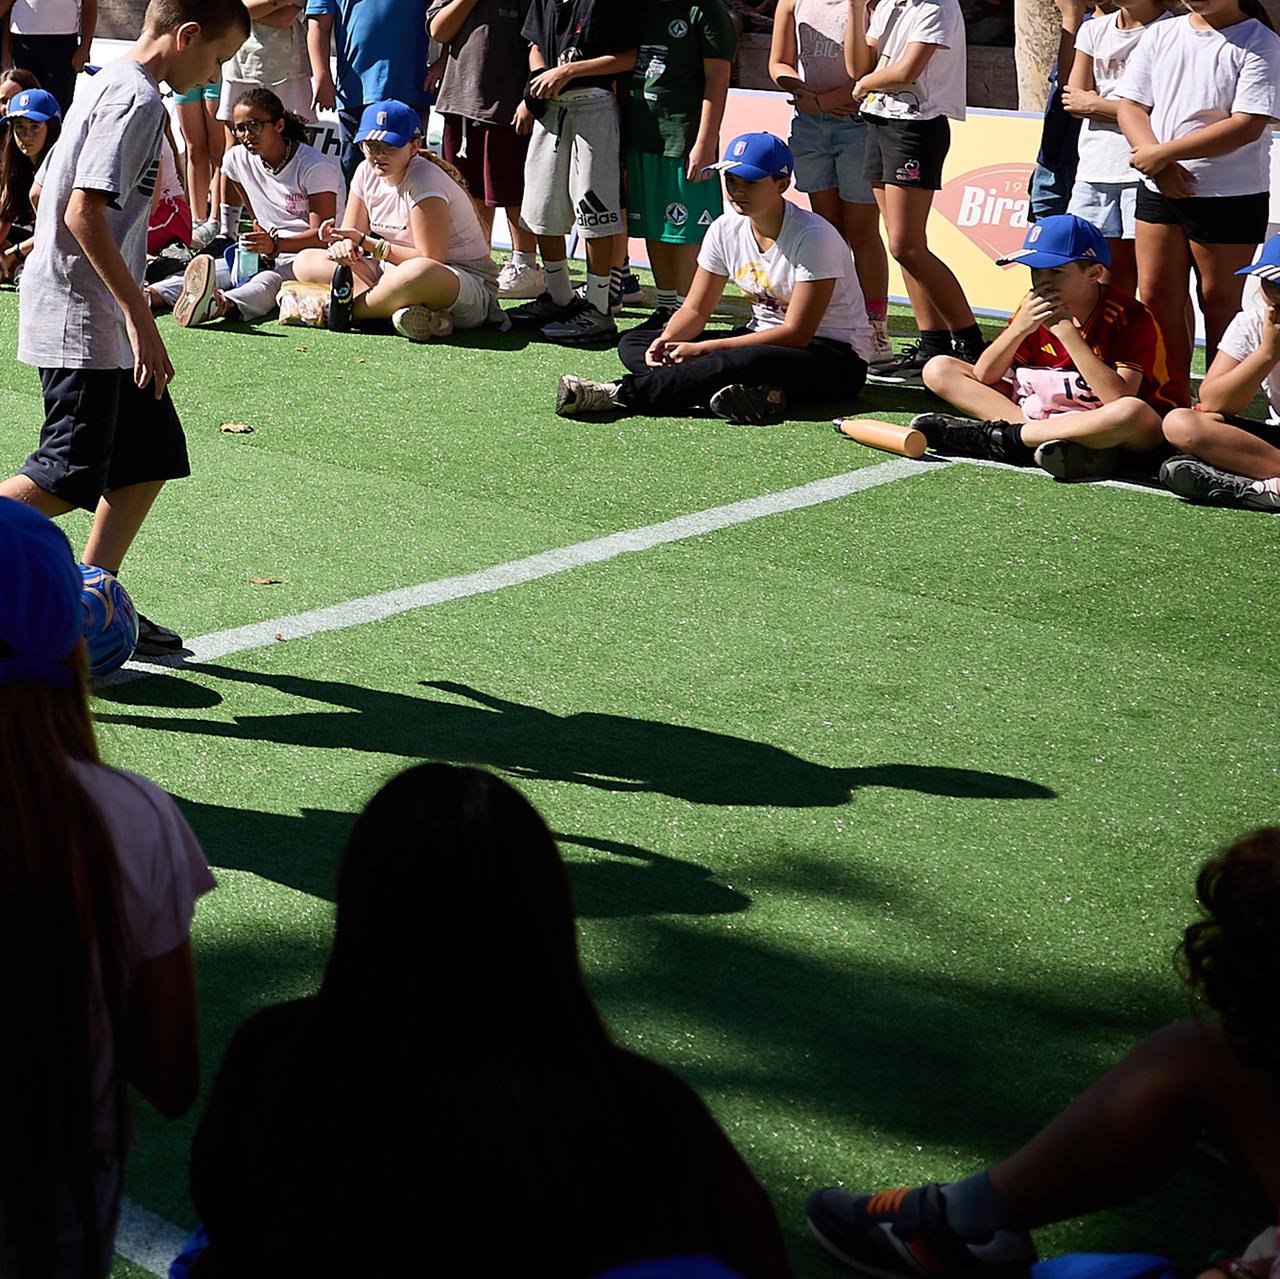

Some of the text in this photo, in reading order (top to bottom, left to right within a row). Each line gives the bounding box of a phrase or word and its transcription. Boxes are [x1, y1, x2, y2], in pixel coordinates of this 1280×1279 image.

[814, 40, 839, 58] BIG
[956, 185, 1030, 229] Bira
[577, 211, 619, 227] didas
